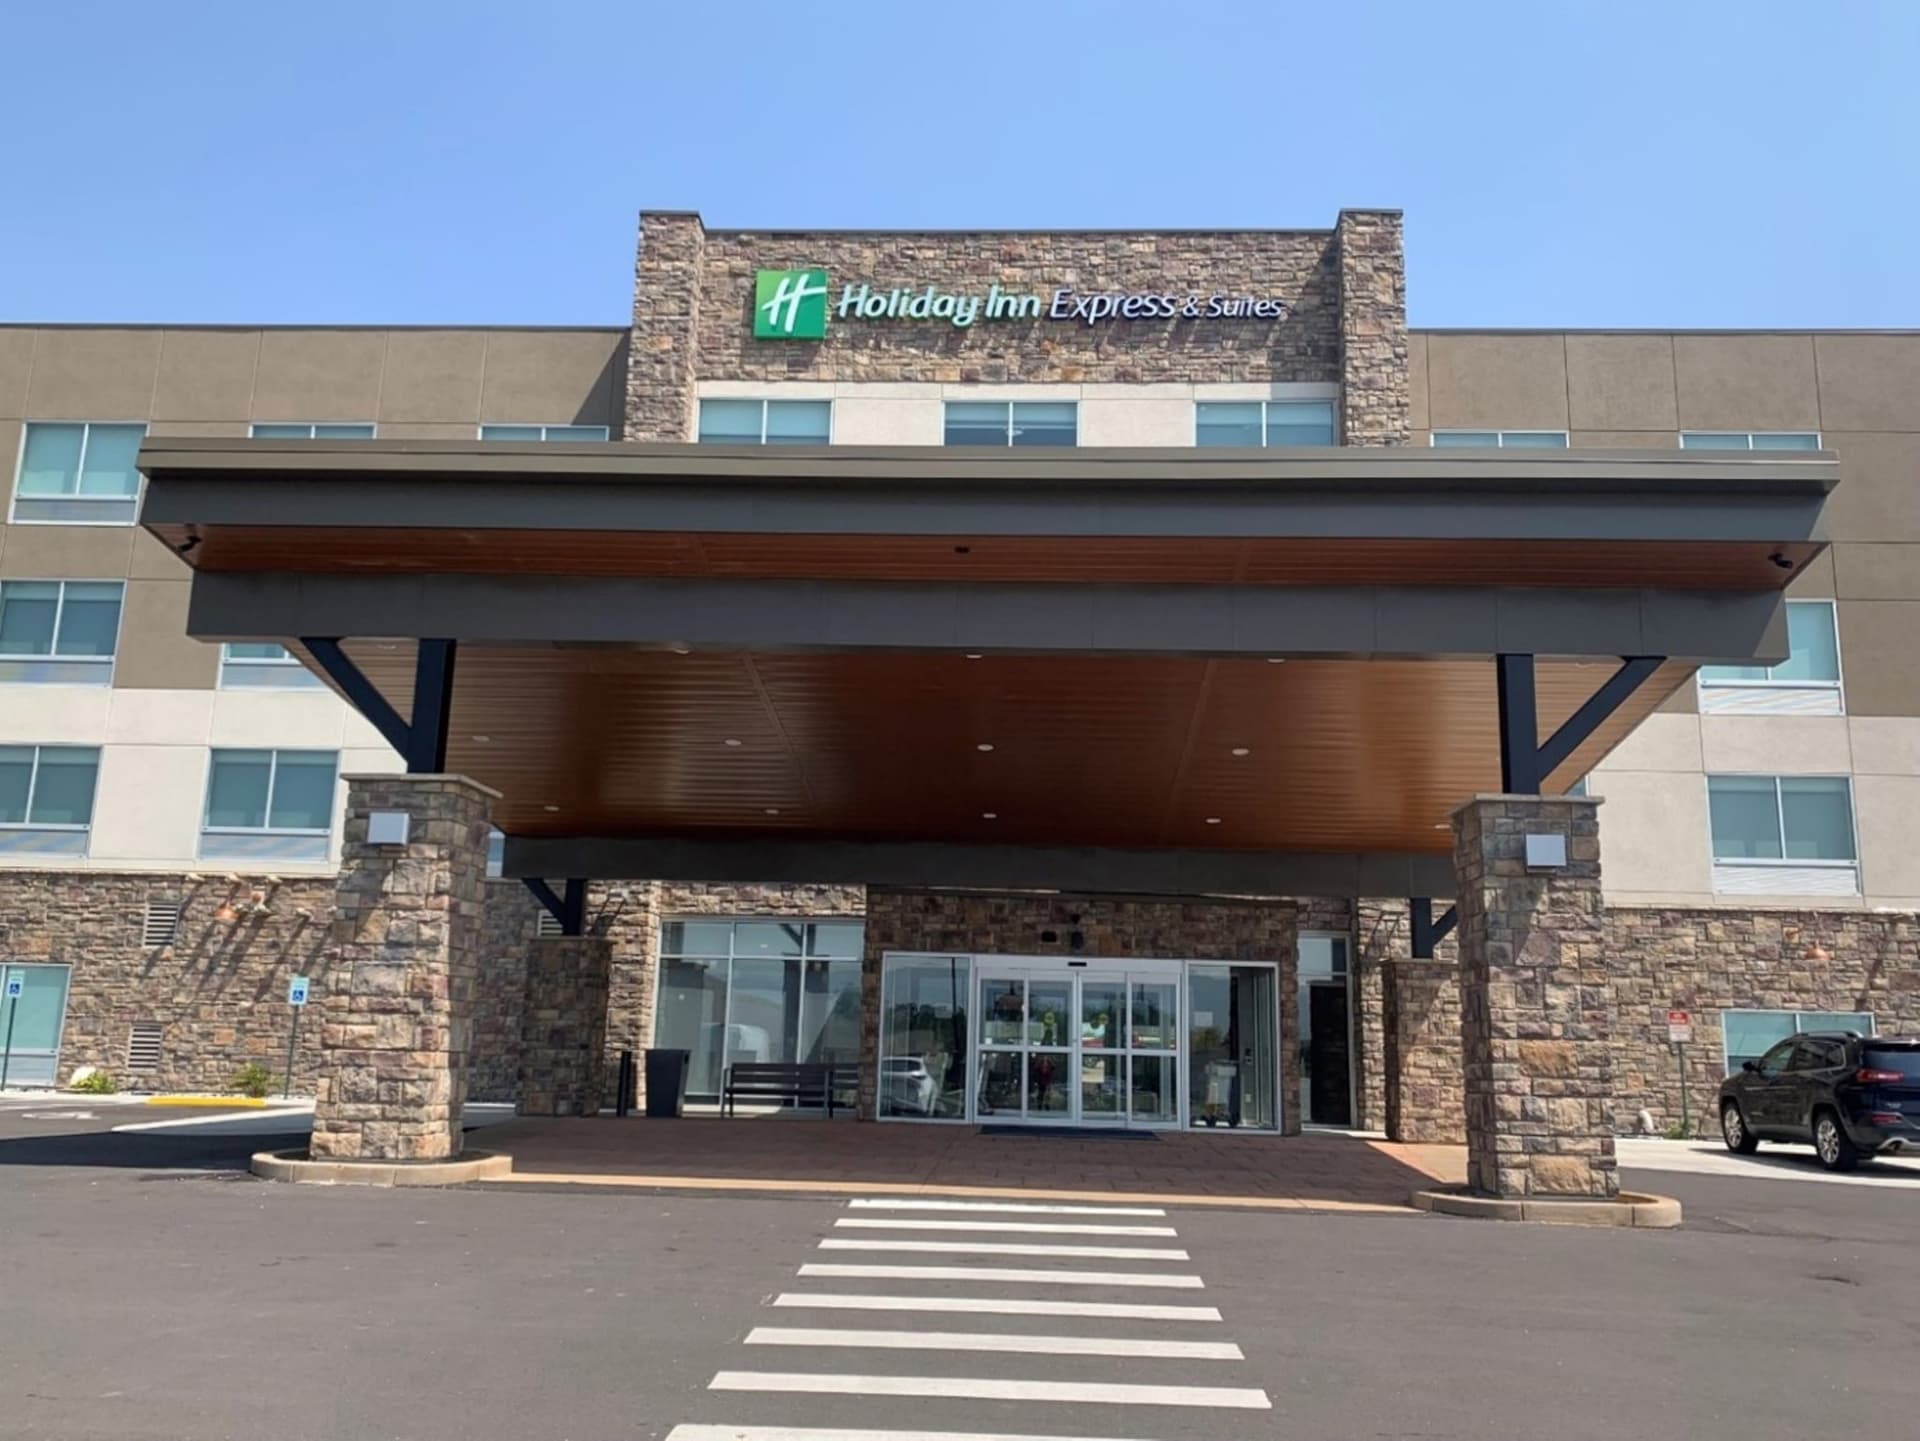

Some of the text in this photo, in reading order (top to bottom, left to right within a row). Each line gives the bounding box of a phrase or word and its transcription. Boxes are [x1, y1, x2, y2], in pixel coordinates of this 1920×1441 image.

[836, 284, 1282, 327] Holiday Inn Express & Suites
